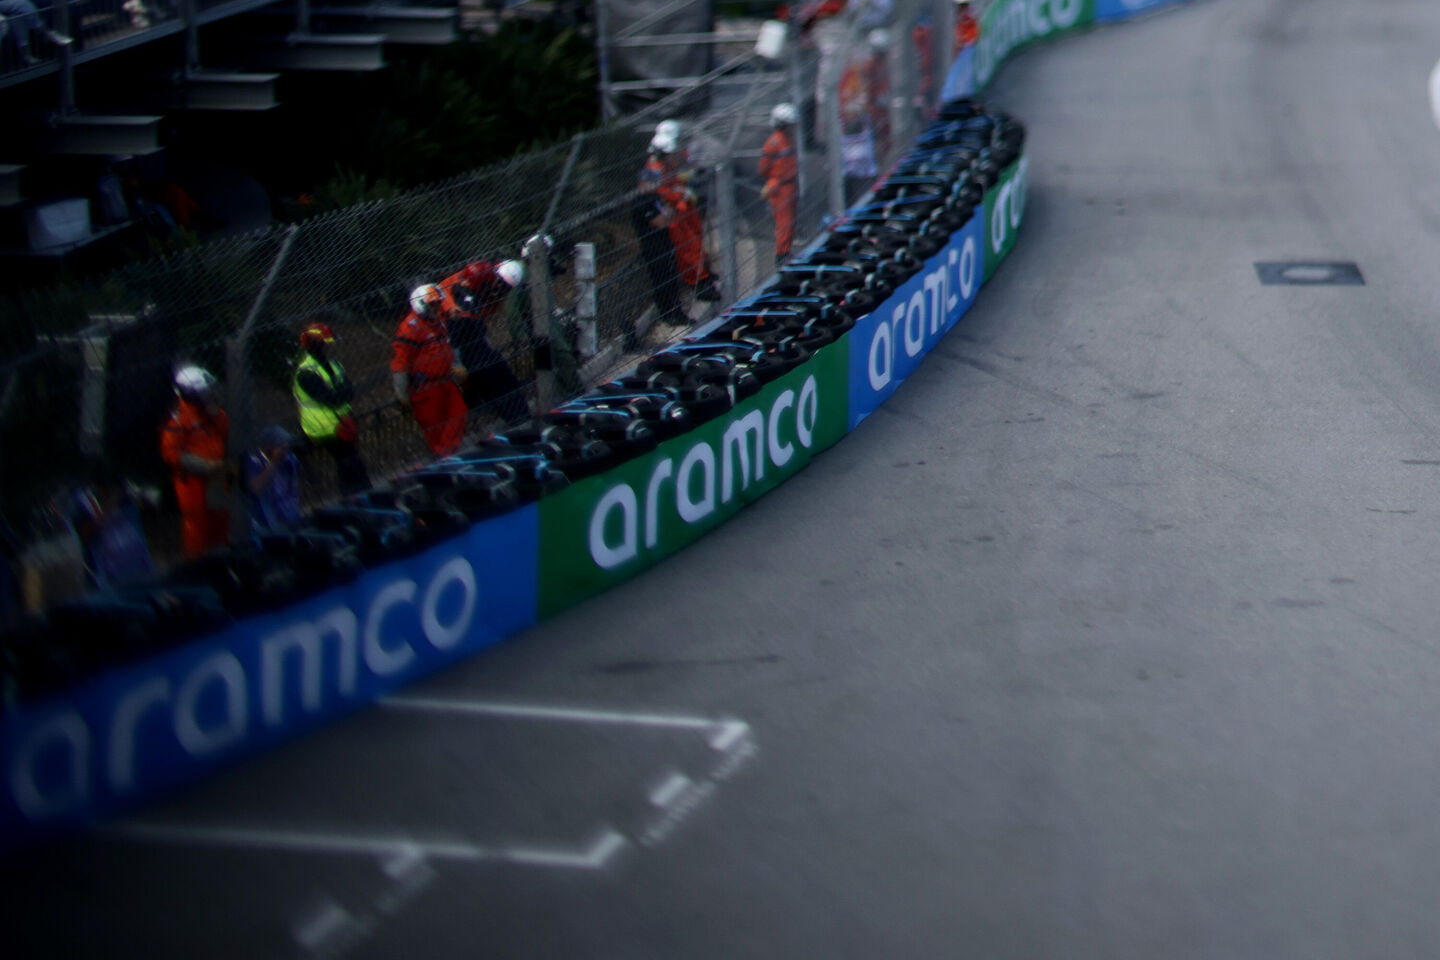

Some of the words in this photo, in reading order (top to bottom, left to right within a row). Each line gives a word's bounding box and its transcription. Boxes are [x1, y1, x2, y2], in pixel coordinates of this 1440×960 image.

[868, 237, 975, 391] aramco
[589, 375, 818, 570] aramco
[10, 556, 478, 823] aramco
